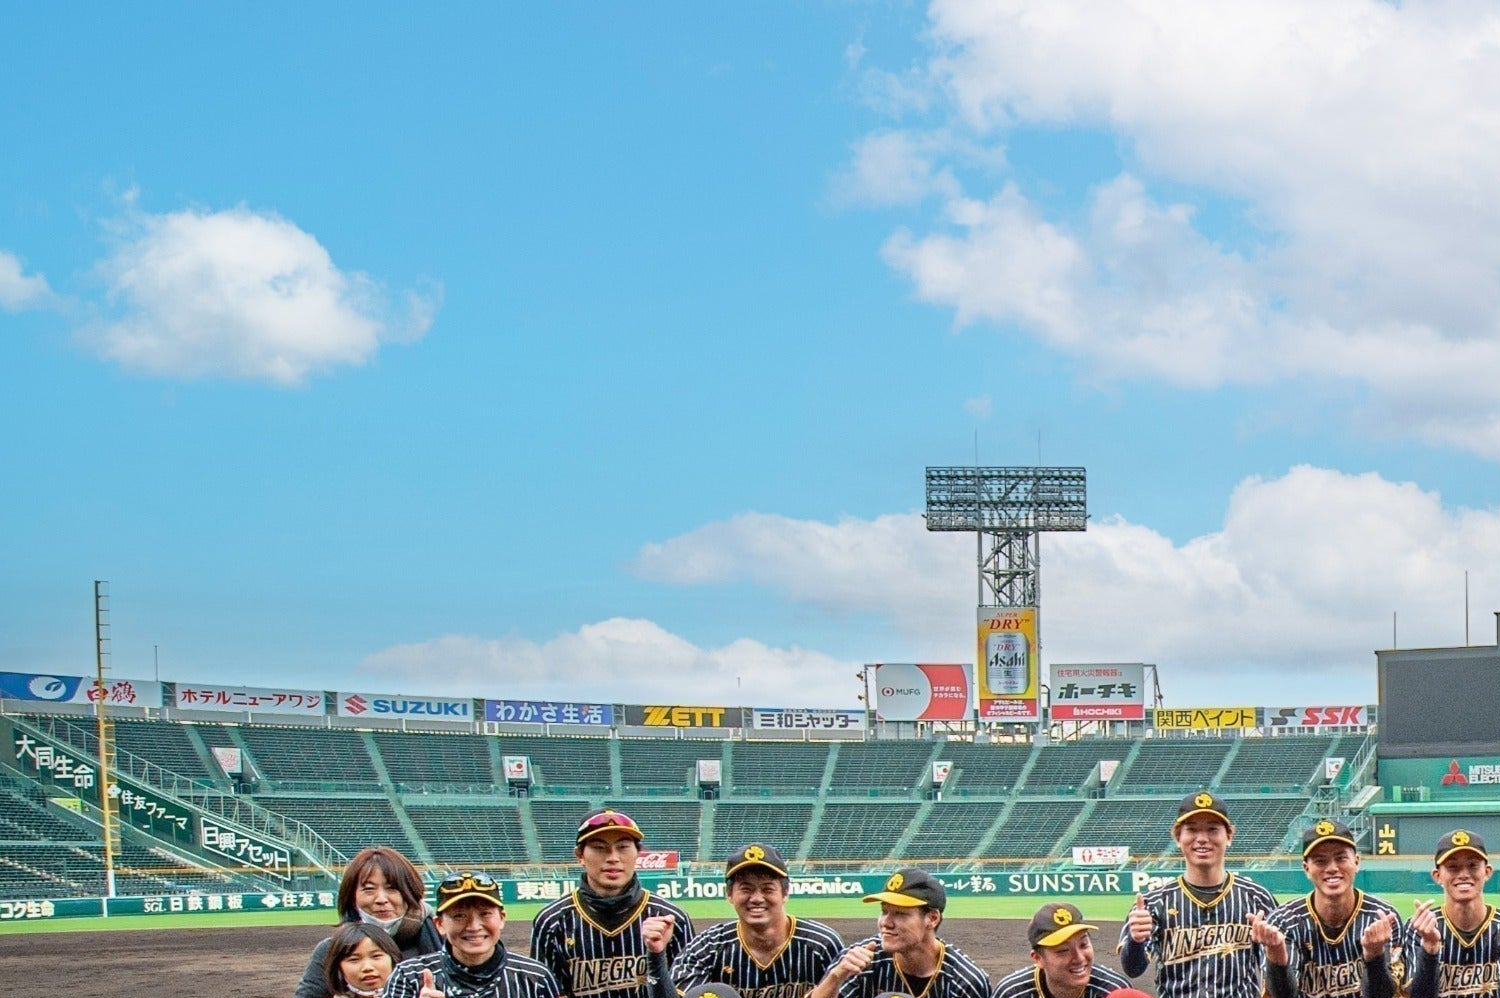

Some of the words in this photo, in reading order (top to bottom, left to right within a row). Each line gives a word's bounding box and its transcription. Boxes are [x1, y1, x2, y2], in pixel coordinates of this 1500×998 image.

[989, 652, 1025, 667] Asahi
[87, 681, 136, 704] 白鶴
[181, 689, 320, 710] ホテルニューアワジ
[896, 688, 921, 696] MUFG
[1058, 683, 1136, 699] ホーチキ
[373, 699, 468, 716] SUZUKI
[495, 702, 603, 724] わかさ生活
[643, 706, 725, 727] ZETT
[1080, 708, 1122, 716] HOCHIKI
[1301, 706, 1364, 725] SSK
[760, 712, 859, 729] 三和シャッター
[1157, 711, 1253, 728] 関西ペイント
[15, 734, 95, 790] 大同生命
[121, 788, 188, 830] 住友ファーマ
[203, 826, 287, 871] 日興アセット
[1009, 874, 1121, 892] SUNSTAR
[170, 894, 243, 912] 日鉄鋼板
[282, 892, 334, 908] 住友電
